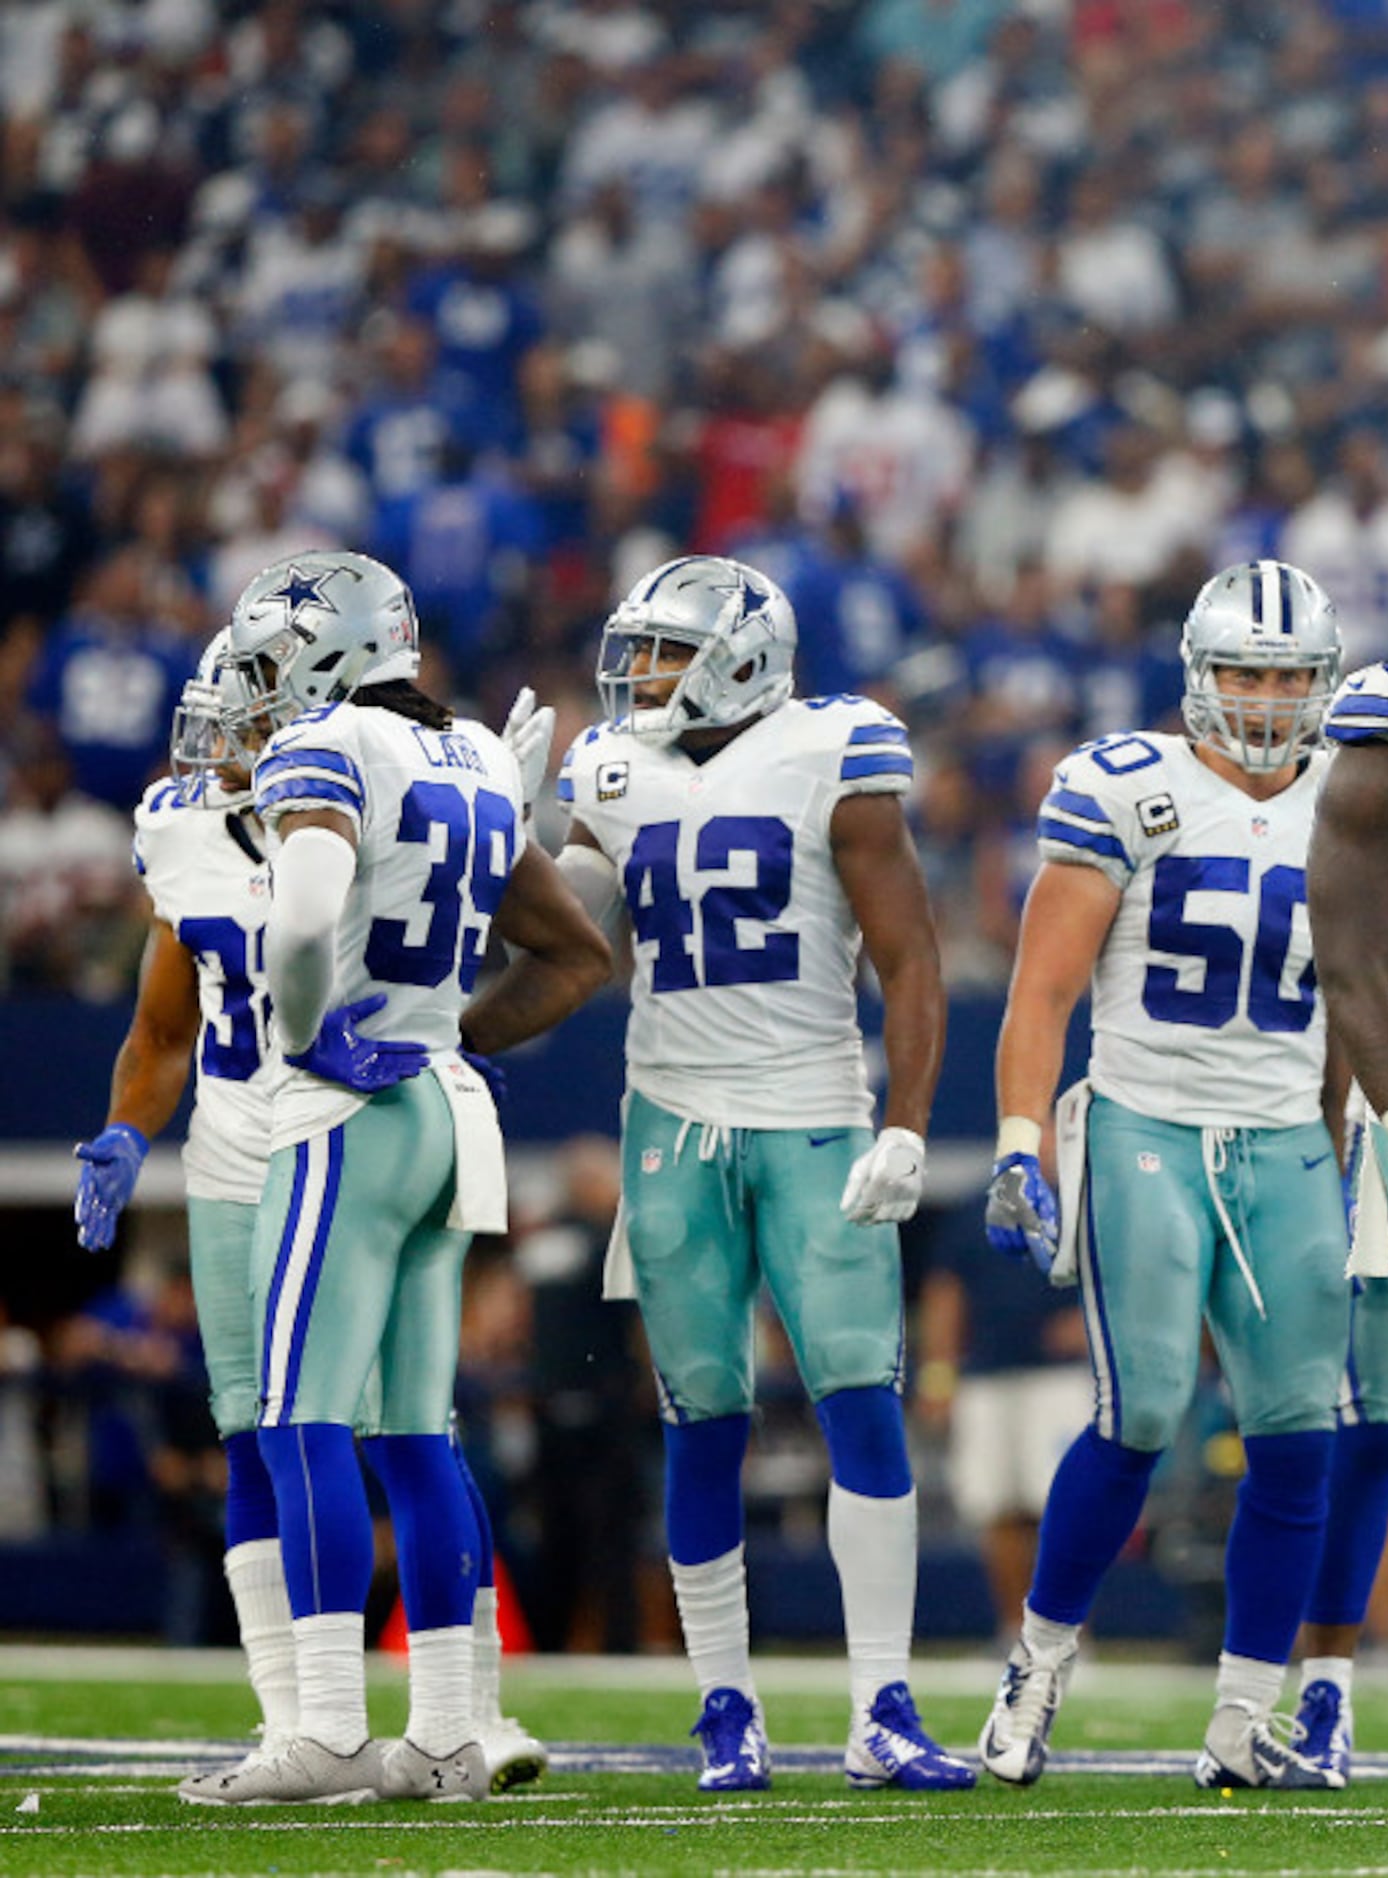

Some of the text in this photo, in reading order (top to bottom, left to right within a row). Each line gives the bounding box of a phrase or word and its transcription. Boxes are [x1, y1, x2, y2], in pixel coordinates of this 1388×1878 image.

[363, 779, 517, 995] 39
[624, 816, 800, 995] 42
[1141, 854, 1318, 1033] 50
[179, 915, 273, 1081] 3
